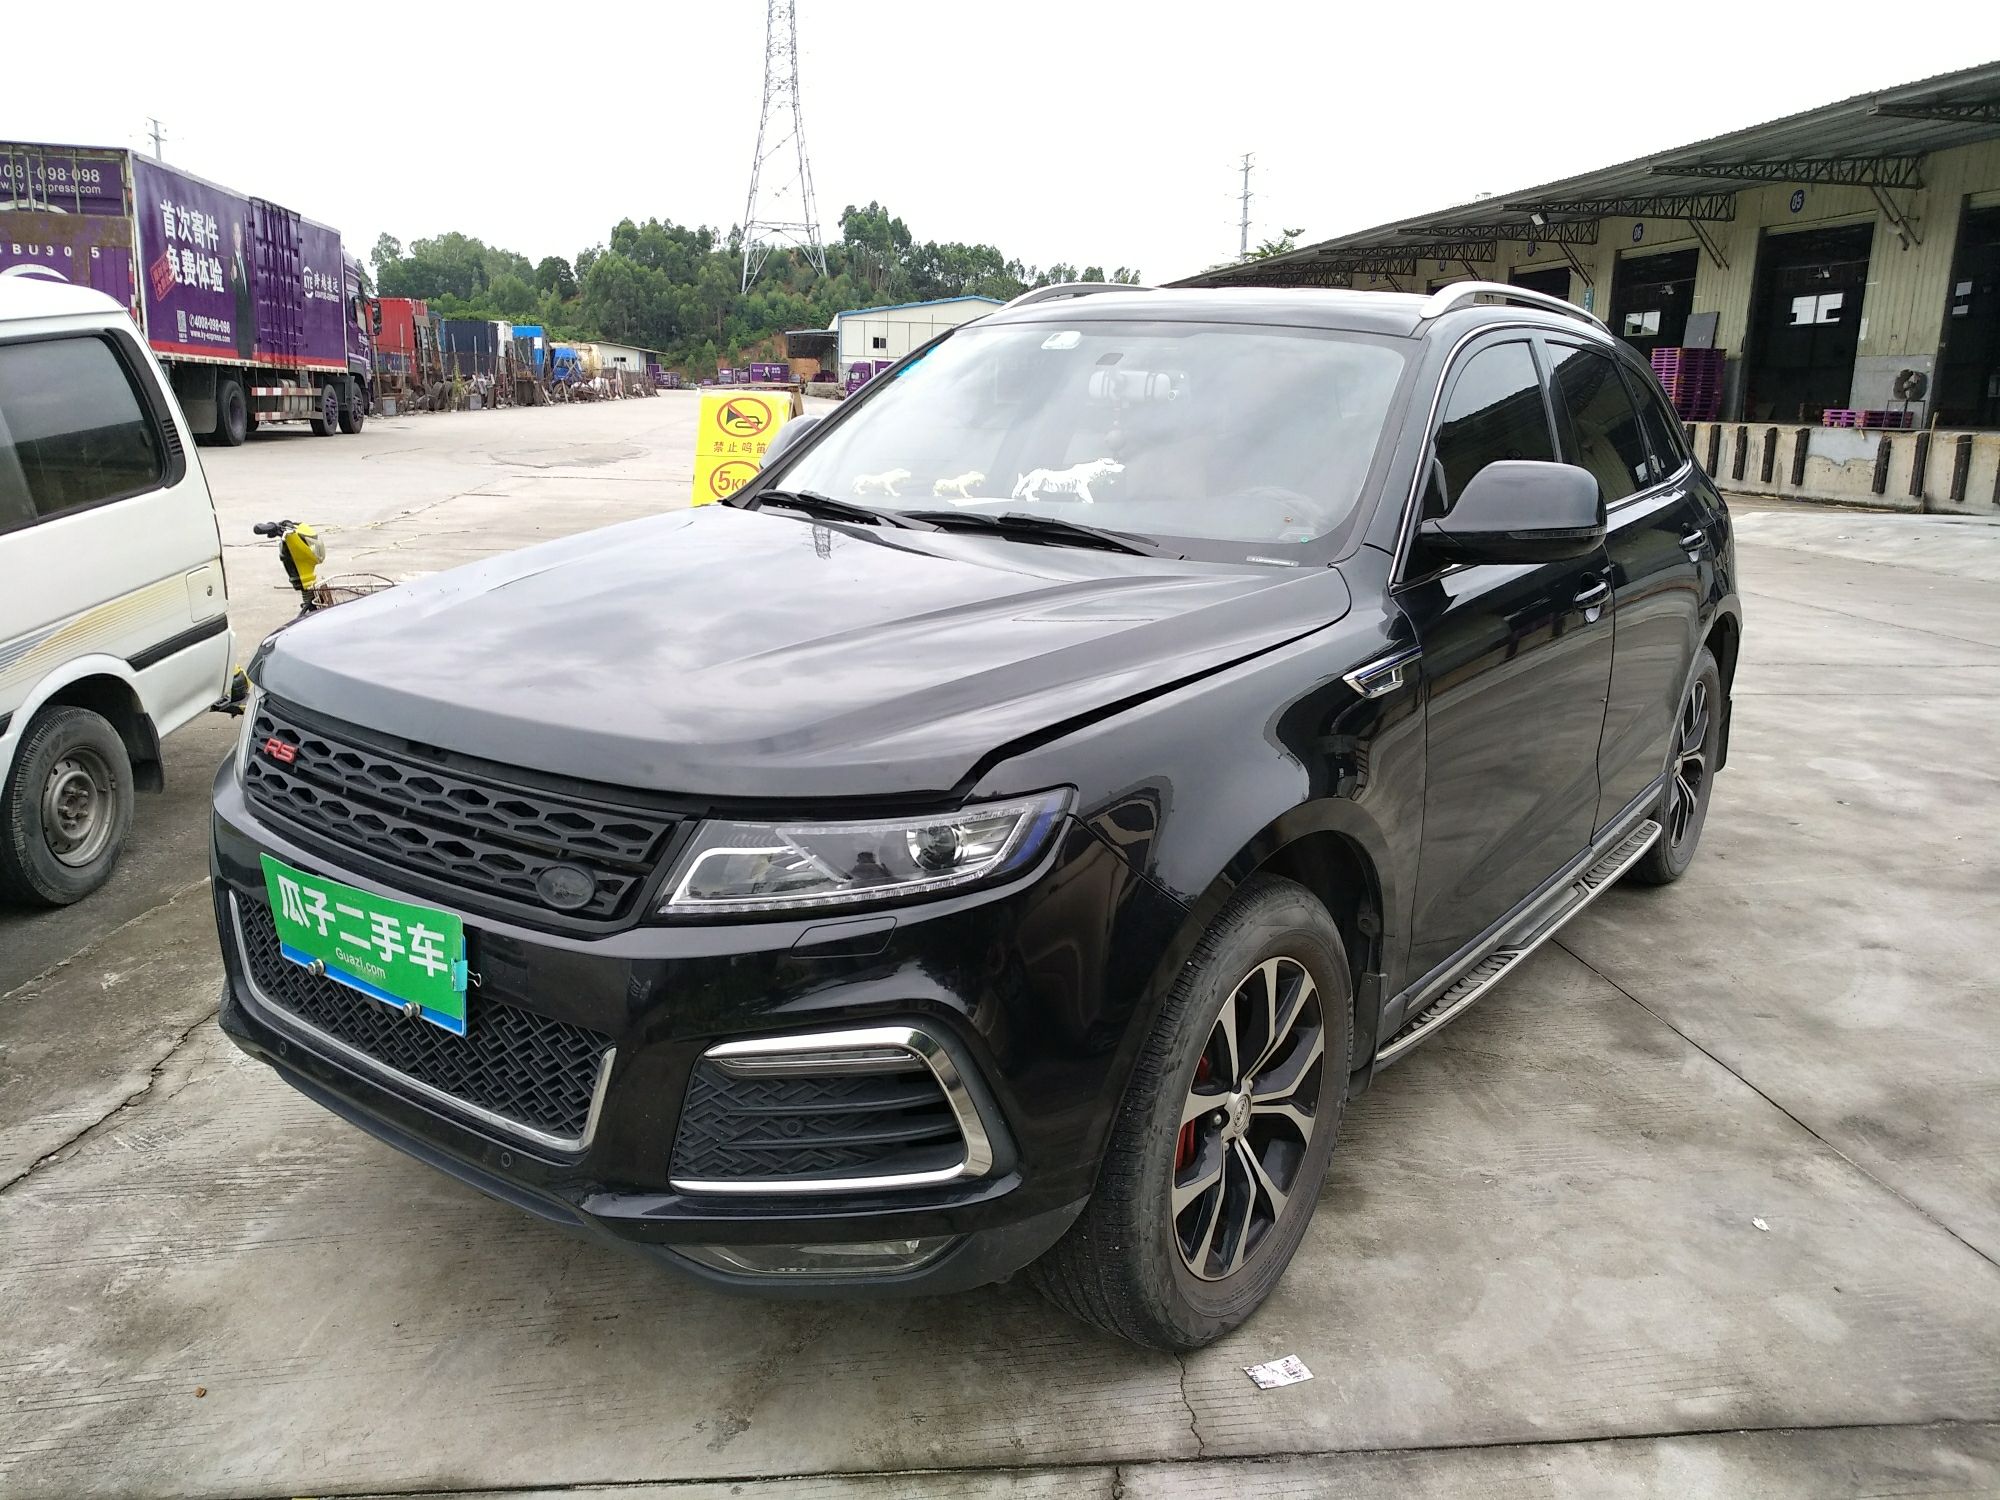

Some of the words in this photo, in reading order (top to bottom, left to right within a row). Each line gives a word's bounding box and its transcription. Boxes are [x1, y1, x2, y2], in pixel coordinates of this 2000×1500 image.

[0, 164, 100, 183] 08-098-098
[160, 199, 219, 252] 首次寄件
[0, 243, 100, 259] BU905
[165, 243, 225, 293] 免费体验
[713, 441, 767, 455] 禁止鸣笛
[264, 736, 296, 764] RS
[276, 873, 449, 977] 瓜子二手车
[335, 946, 387, 980] Guazi.com
